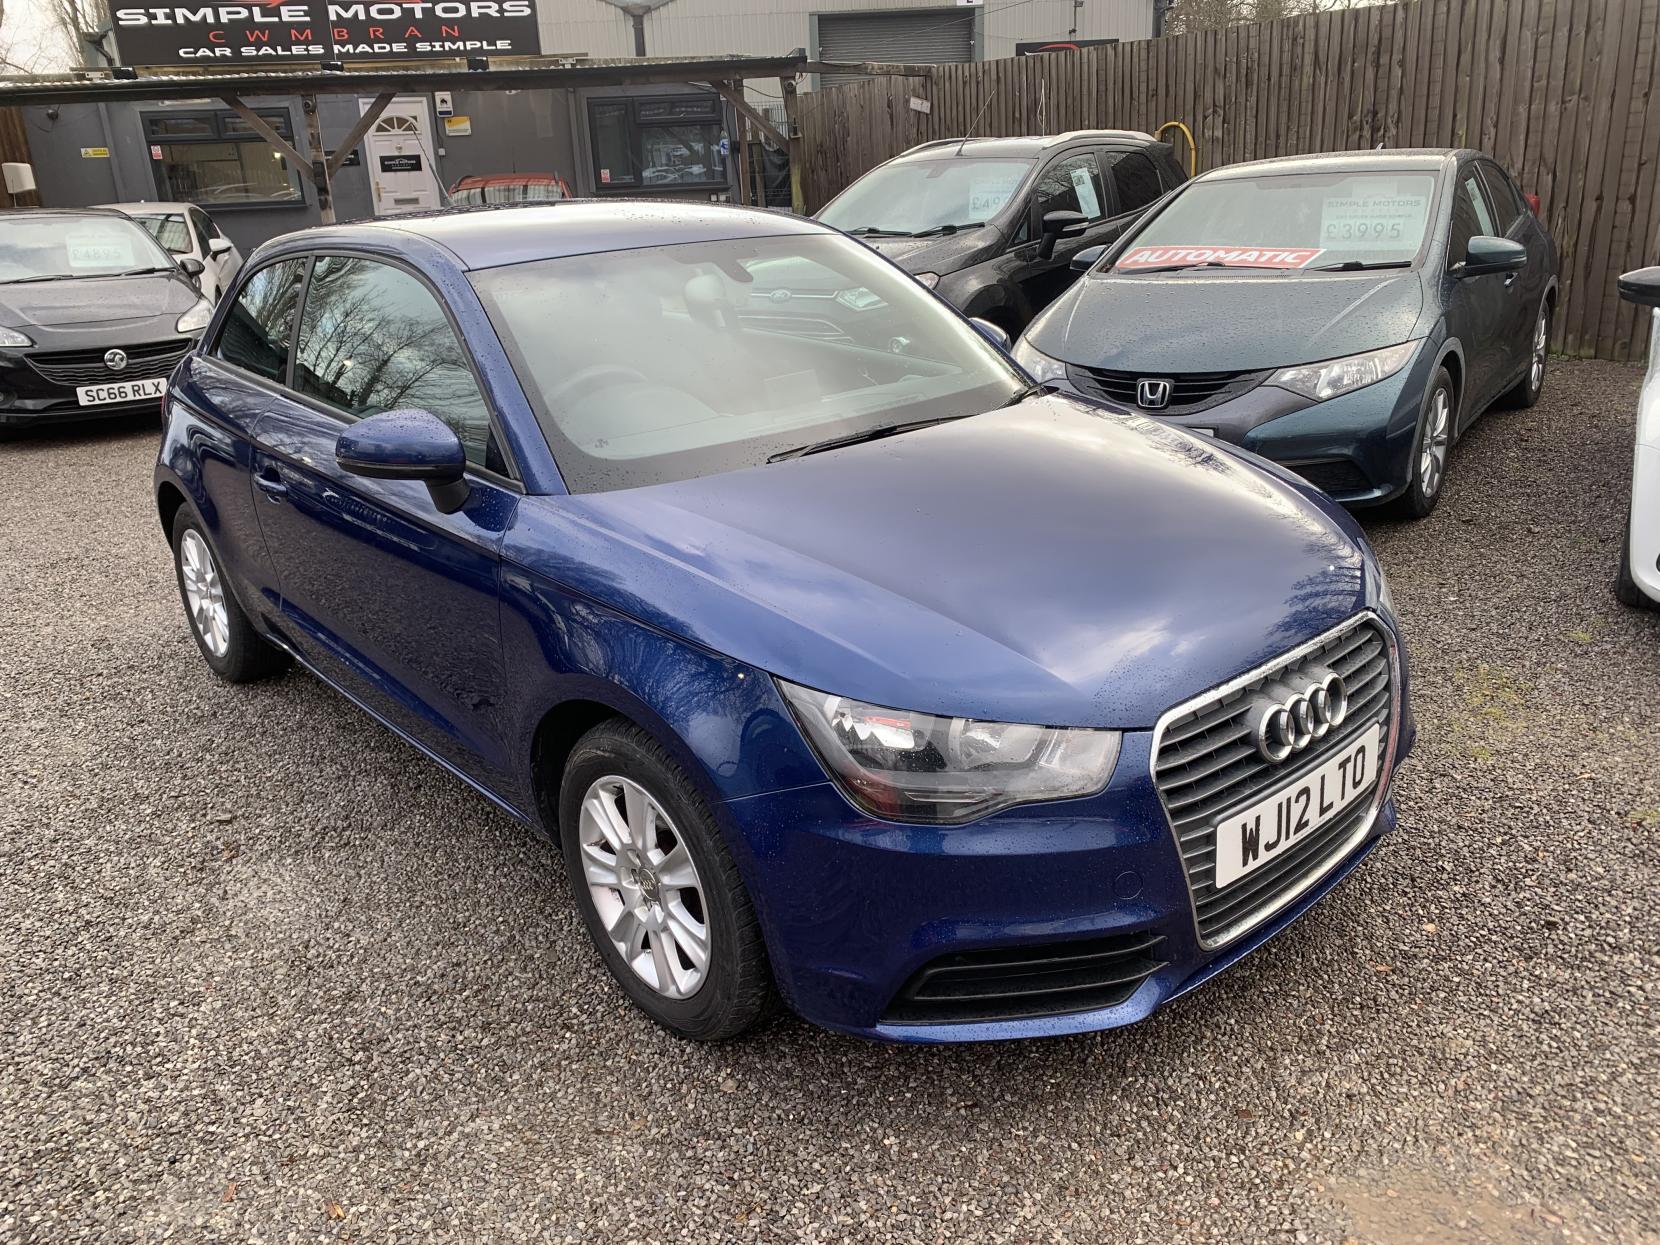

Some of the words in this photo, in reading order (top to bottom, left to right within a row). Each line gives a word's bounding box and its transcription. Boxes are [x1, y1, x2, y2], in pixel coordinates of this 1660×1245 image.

[116, 6, 311, 25] SIMPLE
[327, 1, 532, 20] MOTORS
[209, 25, 460, 43] CWMBRAN
[179, 47, 233, 58] CAR
[241, 45, 325, 56] SALES
[334, 43, 408, 54] MADE
[415, 40, 512, 51] SIMPLE
[1327, 200, 1370, 208] SIMPLE
[1373, 199, 1421, 207] MOTORS
[1325, 222, 1401, 239] £3995
[1126, 249, 1312, 264] AUTOMATIC
[84, 385, 128, 402] SC66
[131, 381, 162, 397] RLX
[1241, 786, 1311, 868] WJ12
[1319, 744, 1366, 818] LTO
